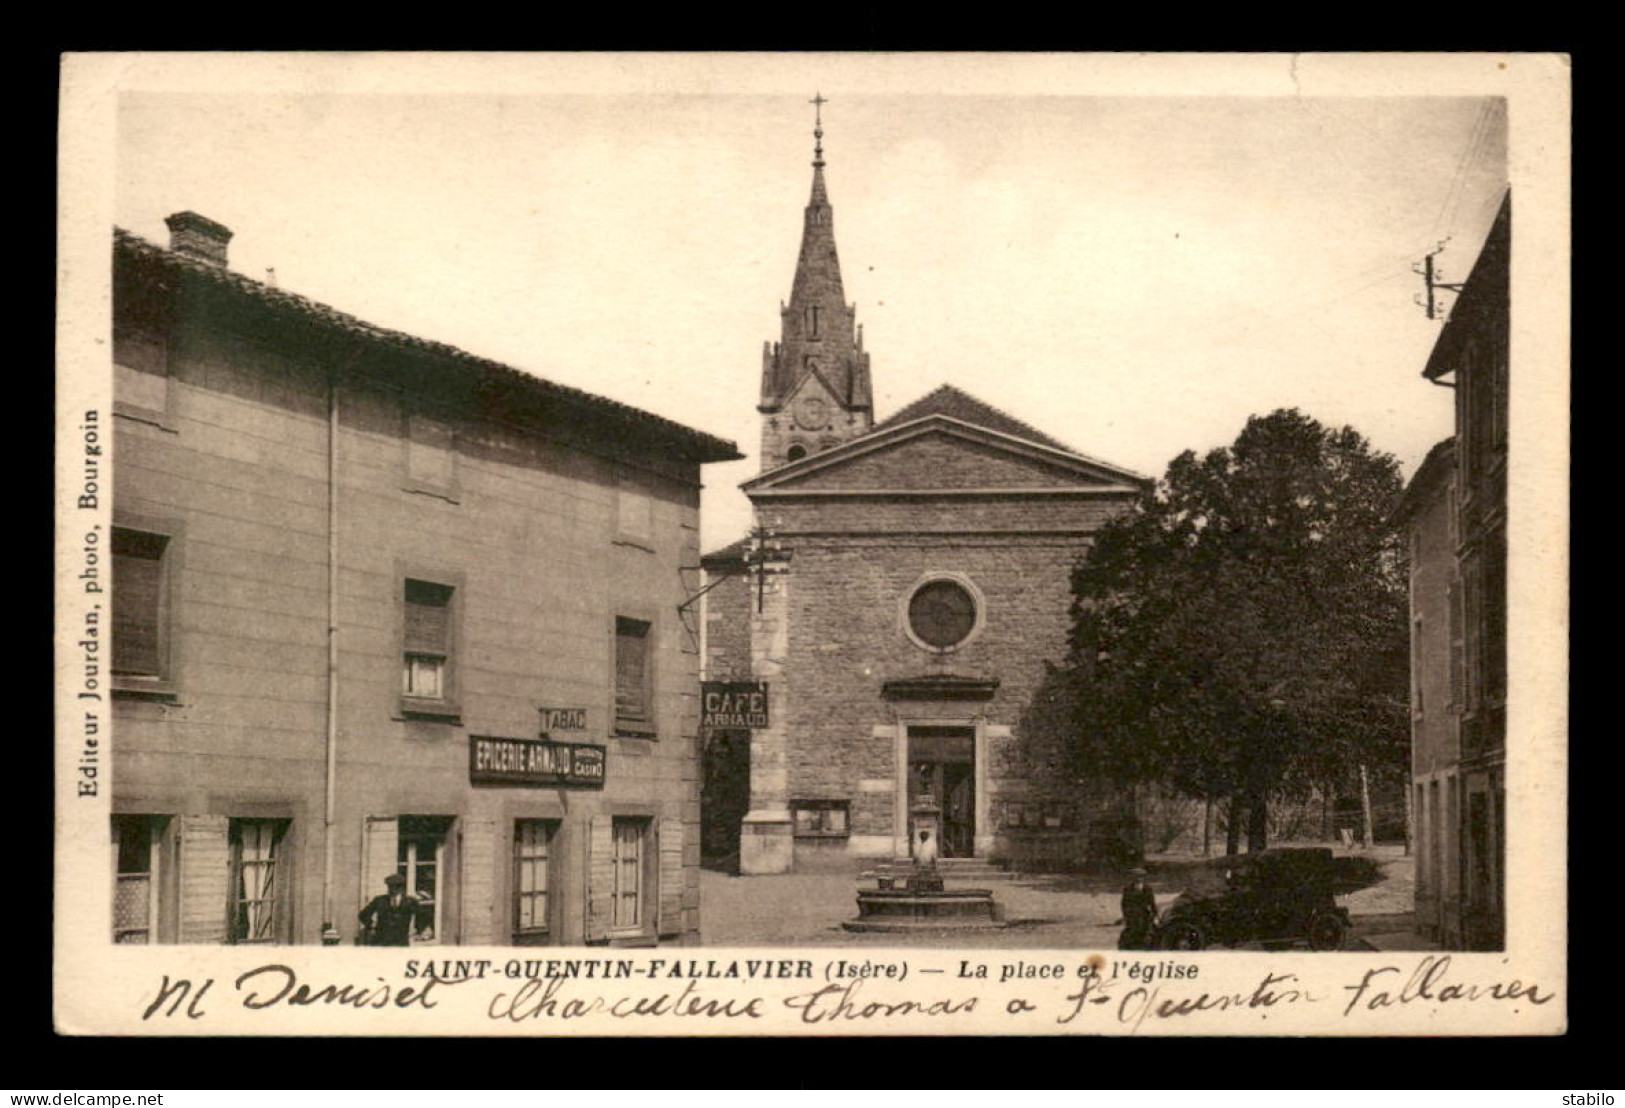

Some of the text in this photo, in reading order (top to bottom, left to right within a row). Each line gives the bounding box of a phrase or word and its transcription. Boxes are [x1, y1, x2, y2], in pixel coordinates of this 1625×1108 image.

[78, 410, 102, 798] Editeur Jourdan, photo, Bourgoin
[544, 710, 585, 729] TABAC
[704, 713, 766, 726] ARNAUD
[476, 740, 526, 772] EPICERIE
[528, 743, 571, 774] ARNAUD
[404, 960, 813, 979] SAINT-QUENTIN-FALLAVIER
[825, 961, 908, 981] (Isère)
[958, 961, 988, 979] La
[1000, 961, 1065, 982] place
[1077, 962, 1099, 978] et
[1112, 961, 1199, 983] l'église
[783, 979, 980, 1024] Thomas
[1344, 955, 1556, 1017] Fallavier
